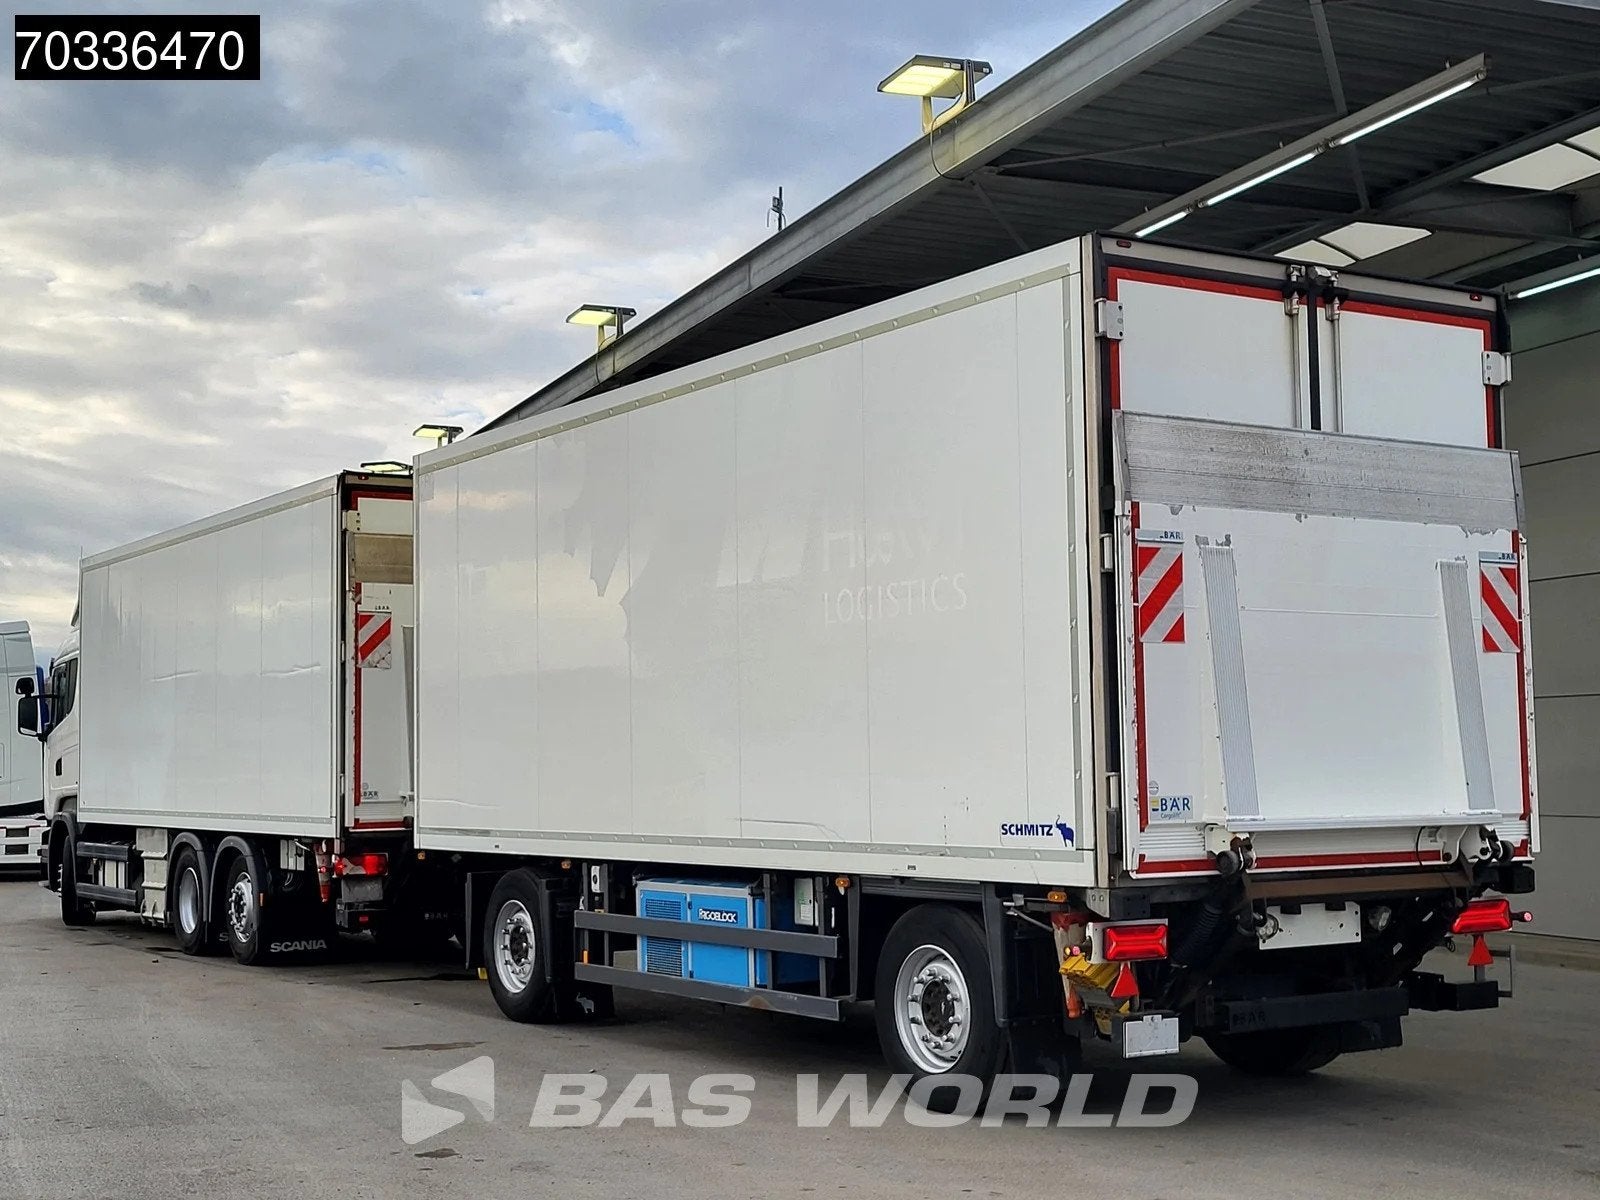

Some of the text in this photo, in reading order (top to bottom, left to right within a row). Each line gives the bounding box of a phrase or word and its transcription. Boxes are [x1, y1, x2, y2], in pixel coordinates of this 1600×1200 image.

[822, 571, 968, 628] LOGISTICS
[1160, 796, 1191, 812] BÄR
[1001, 822, 1054, 837] SCHMITZ
[269, 939, 327, 953] SCANIA
